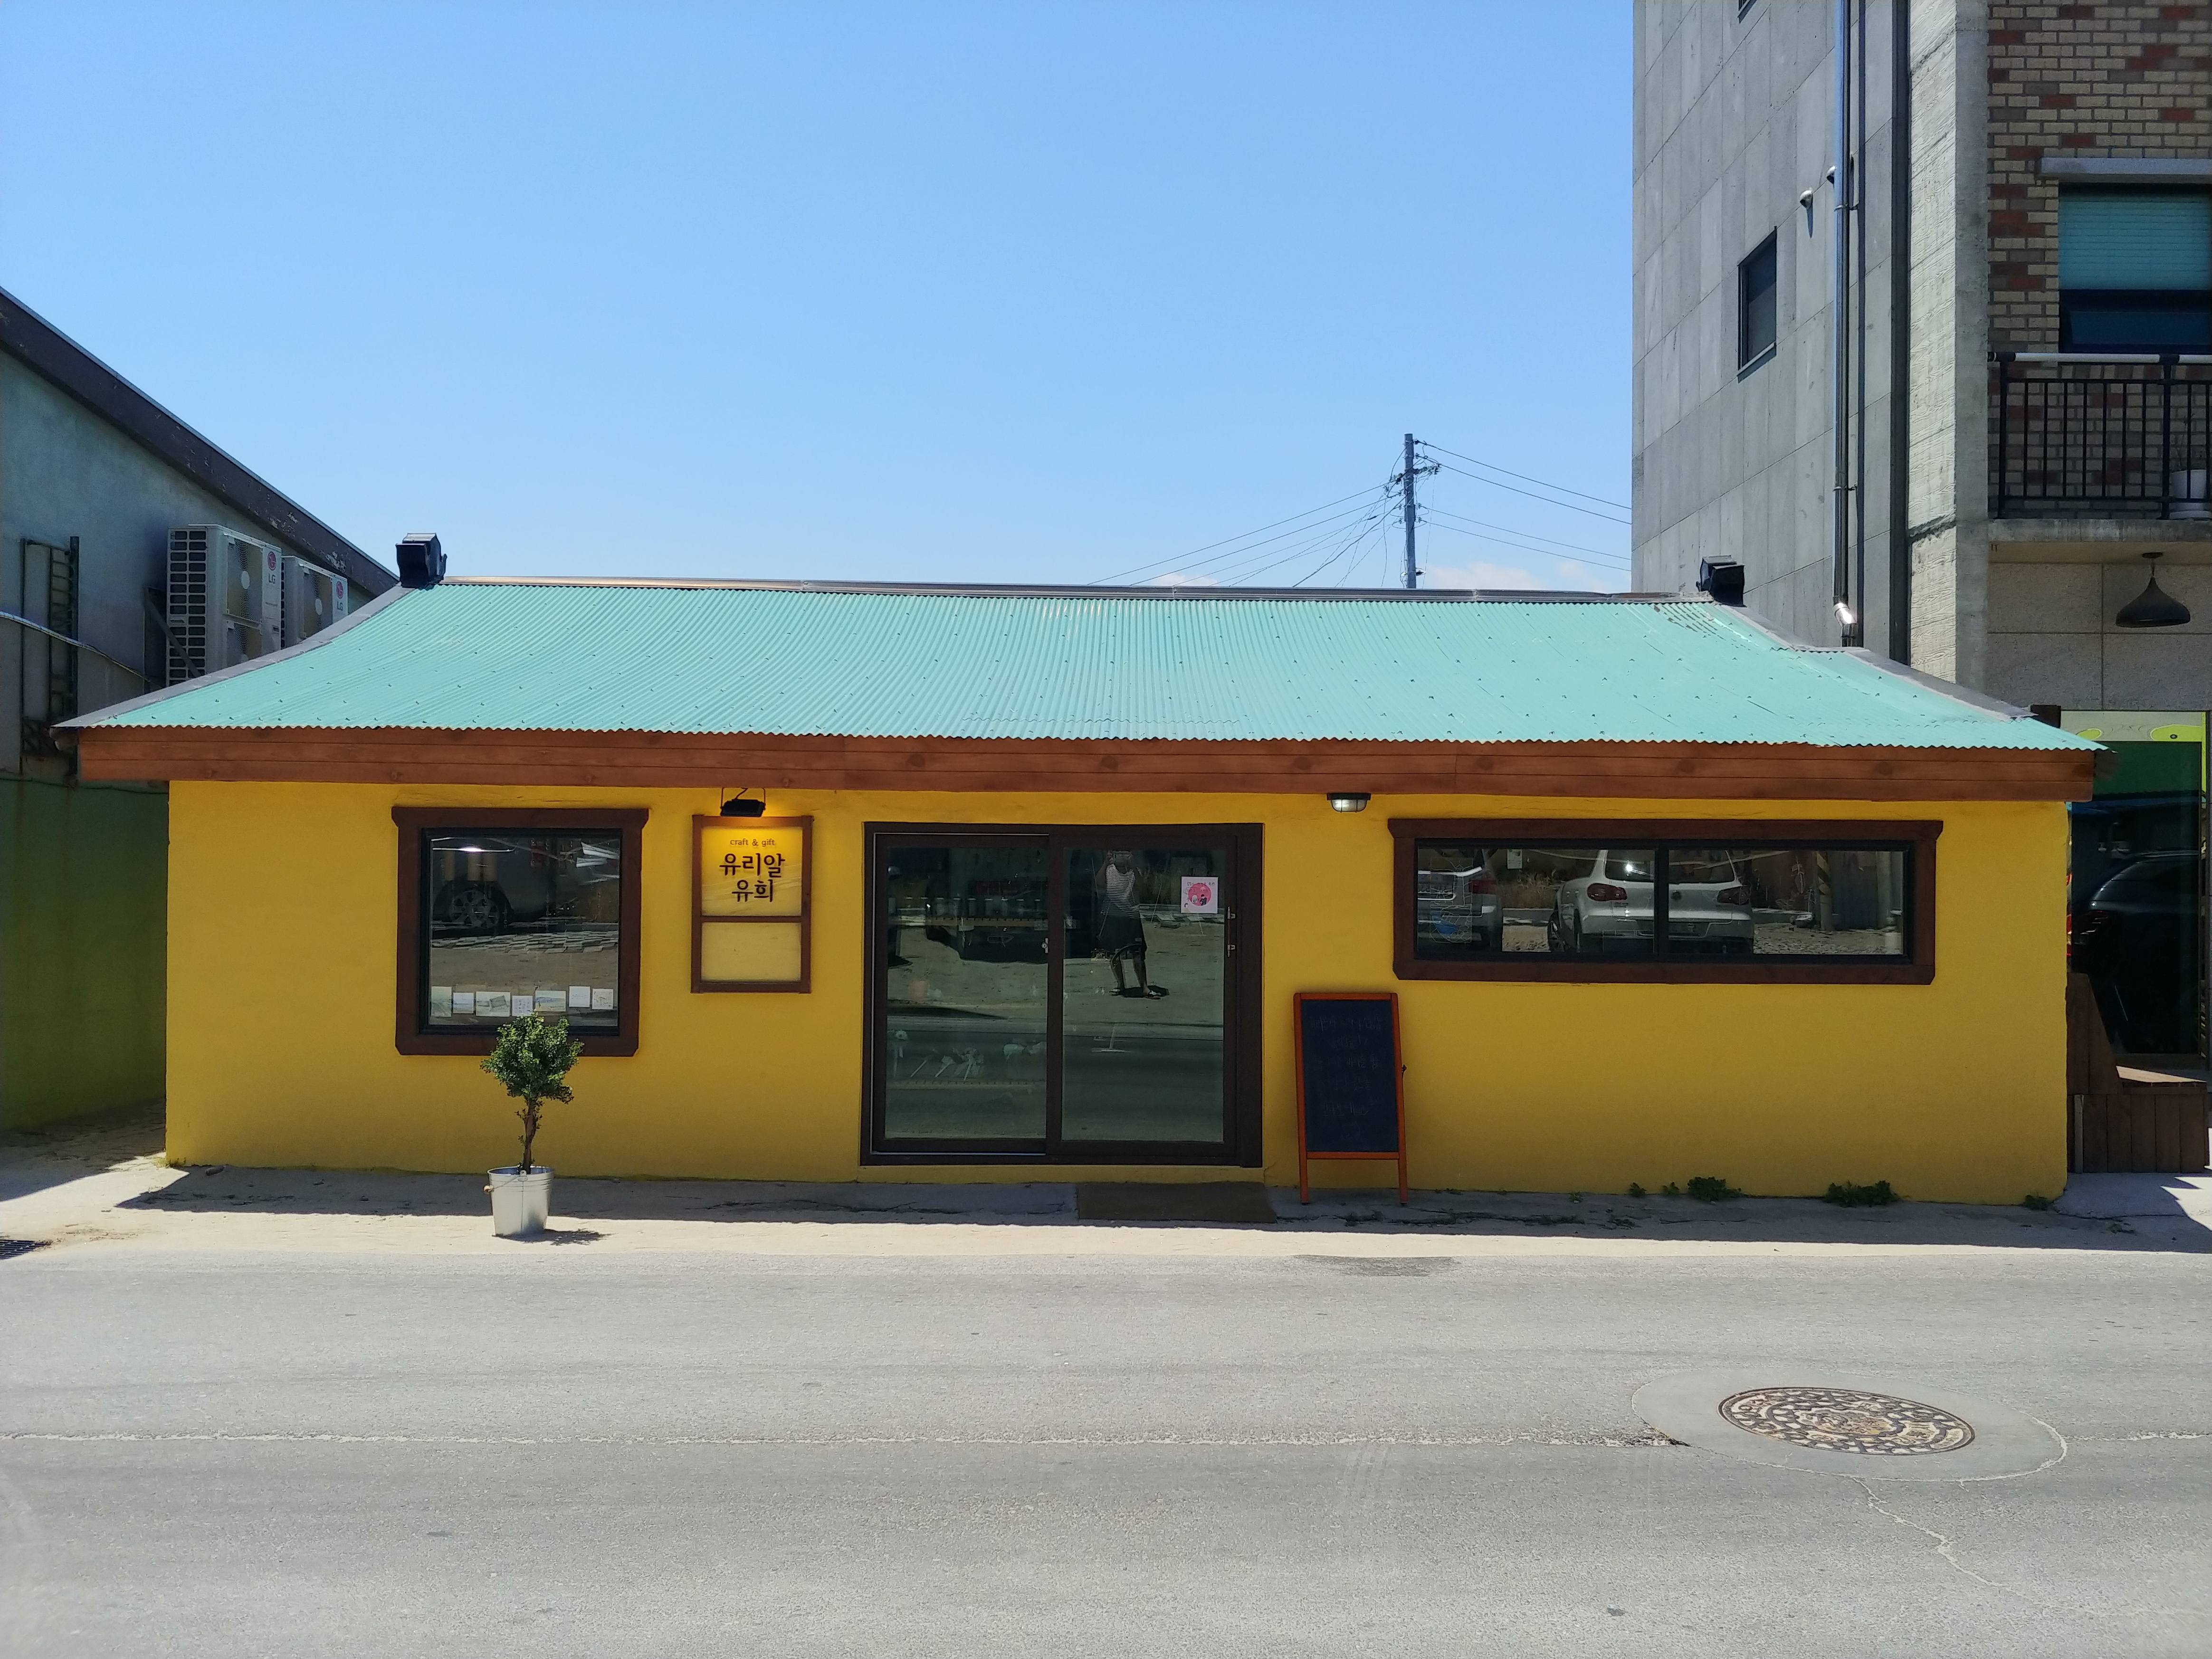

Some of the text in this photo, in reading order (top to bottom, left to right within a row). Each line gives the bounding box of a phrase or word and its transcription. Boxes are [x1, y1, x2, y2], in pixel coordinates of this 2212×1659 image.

[268, 573, 276, 584] LG
[336, 601, 343, 611] LG
[762, 839, 775, 847] gift
[719, 853, 785, 878] 유리알
[732, 879, 773, 903] 유희
